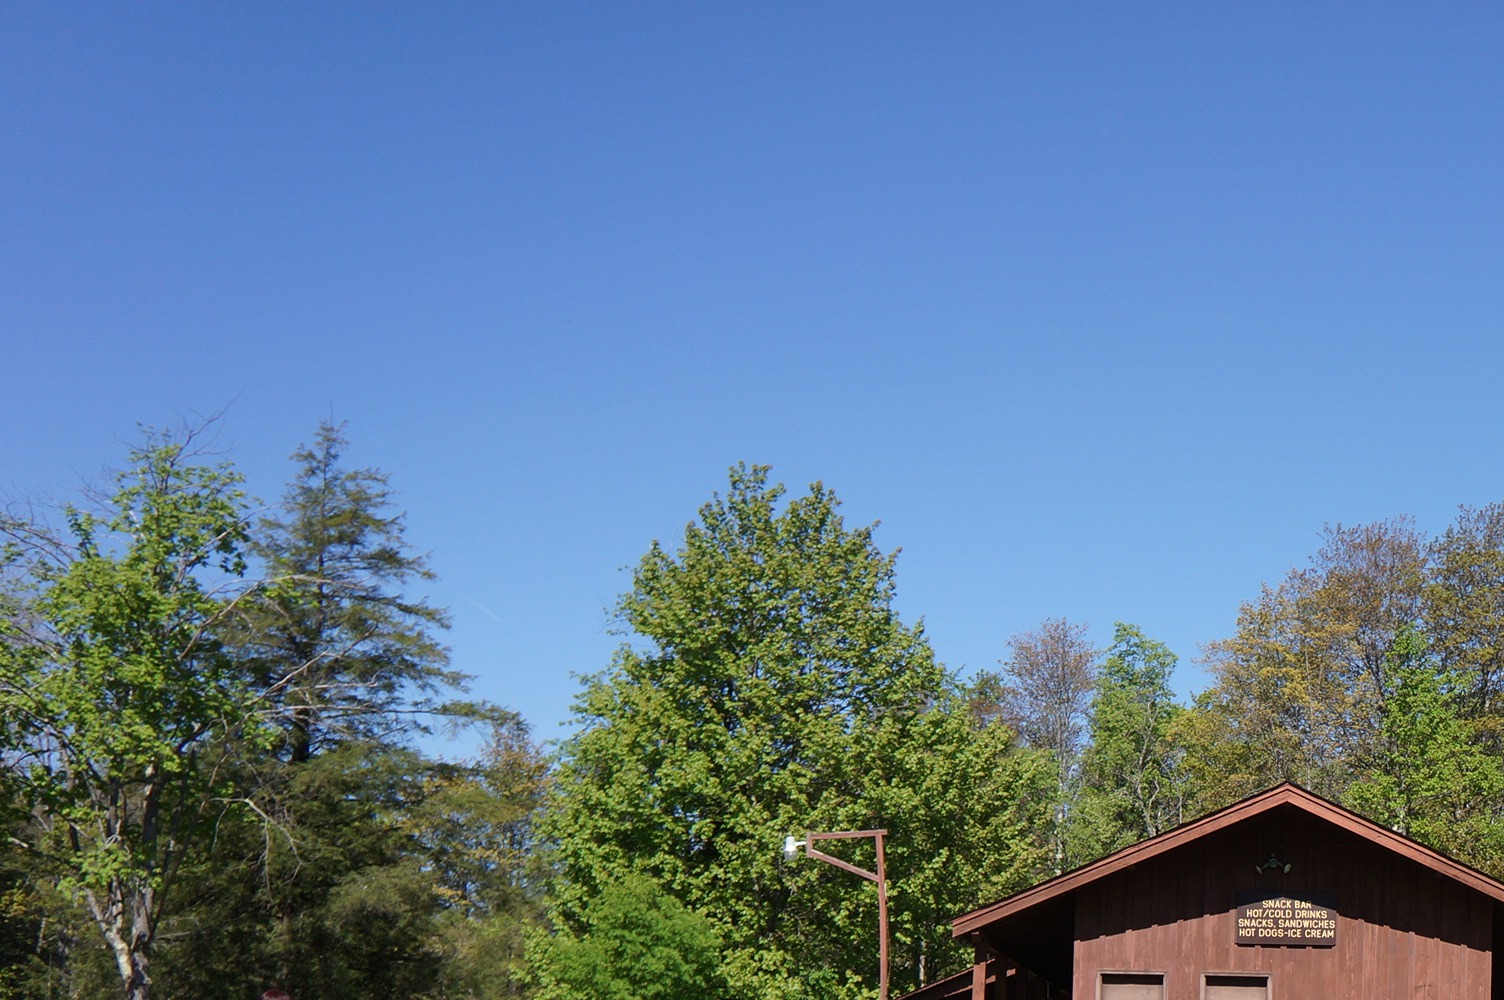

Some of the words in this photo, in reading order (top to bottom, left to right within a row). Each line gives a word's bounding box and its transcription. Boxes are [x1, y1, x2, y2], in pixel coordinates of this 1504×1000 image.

[1262, 900, 1292, 908] SNACK
[1294, 900, 1312, 909] BAR
[1246, 909, 1292, 919] HOT/COLD
[1295, 910, 1327, 919] DRINKS
[1238, 919, 1276, 928] SNACKS,
[1278, 919, 1336, 929] SANDWICHES
[1239, 928, 1255, 937] HOT
[1258, 928, 1302, 938] DOGS-ICE
[1304, 929, 1335, 938] CREAM
